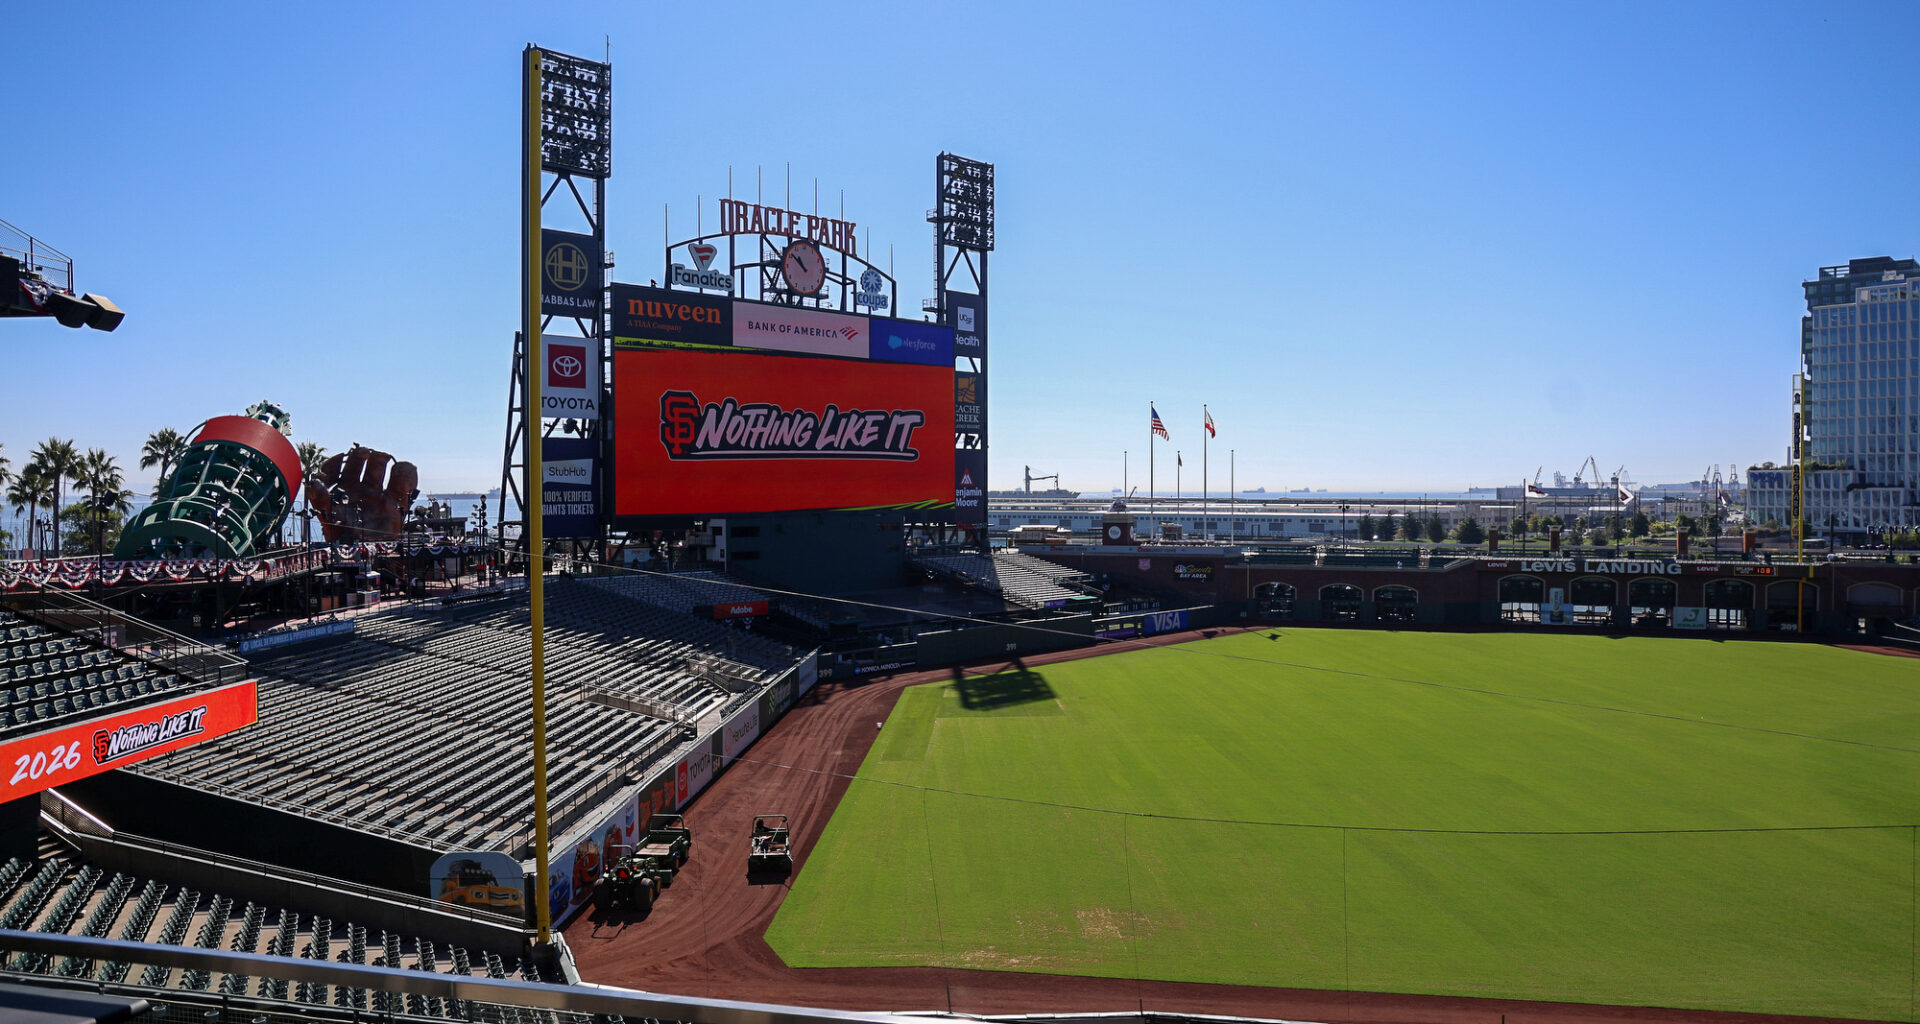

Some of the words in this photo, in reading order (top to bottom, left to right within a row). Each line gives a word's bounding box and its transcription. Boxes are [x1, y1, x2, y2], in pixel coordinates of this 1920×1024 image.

[719, 198, 801, 238] ORACLE
[807, 215, 857, 258] PARK
[675, 266, 732, 288] Fanatics
[577, 298, 596, 308] LAW
[858, 293, 887, 310] coupa
[627, 299, 722, 324] nuveen
[748, 320, 776, 332] BANK
[779, 324, 792, 334] OF
[794, 326, 838, 339] AMERICA
[541, 396, 596, 410] TOYOTA
[696, 402, 813, 449] NOTHING
[815, 408, 885, 450] LIKE
[885, 414, 921, 452] IT
[548, 466, 587, 476] StubHub
[544, 491, 562, 502] 100%
[563, 490, 592, 502] VERIFIED
[542, 504, 566, 516] GIANTS
[567, 504, 594, 516] TICKETS
[1866, 525, 1908, 535] BANK
[1584, 562, 1682, 574] LANDING
[730, 605, 753, 614] Adobe
[1152, 612, 1181, 632] VISA
[818, 668, 832, 678] 399
[861, 664, 880, 673] KONICA
[880, 662, 902, 670] MINOLTA
[108, 724, 158, 757] NOTHING
[159, 711, 189, 739] LIKE
[188, 707, 206, 731] IT
[9, 741, 81, 786] 2026
[690, 752, 710, 781] TOYOTA
